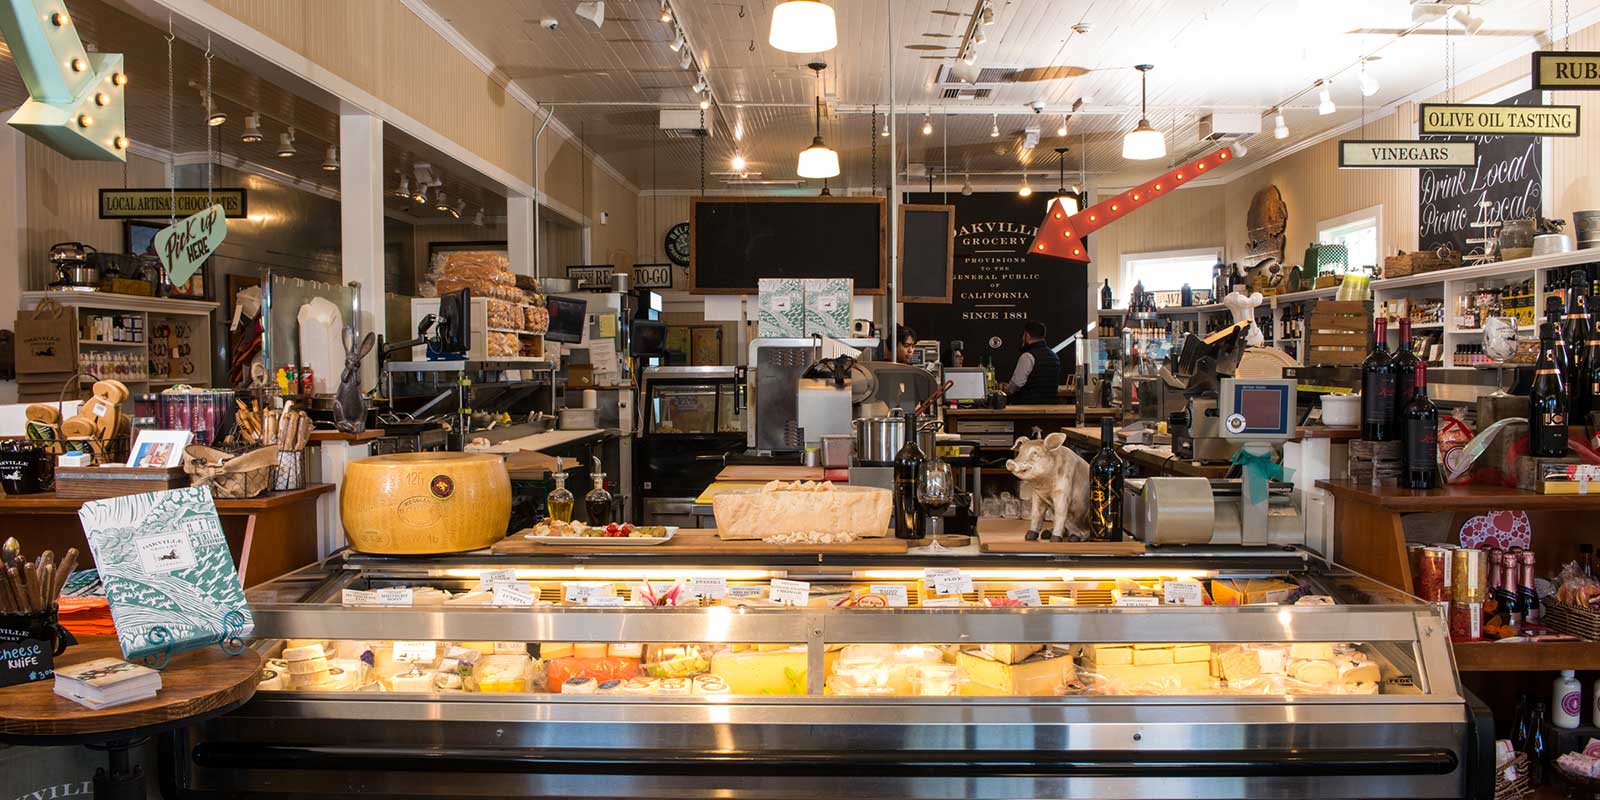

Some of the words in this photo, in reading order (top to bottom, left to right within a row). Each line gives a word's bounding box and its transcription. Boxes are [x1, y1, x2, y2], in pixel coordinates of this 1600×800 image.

[1429, 112, 1473, 127] OLIVE
[1478, 112, 1504, 127] OIL
[1508, 113, 1571, 128] TASTING
[1372, 148, 1449, 160] VINEGARS
[1420, 167, 1468, 205] Drink
[1470, 143, 1534, 192] Local
[106, 197, 135, 210] LOCAL
[179, 196, 238, 211] CHOCOTES
[1421, 203, 1467, 237] Picnic
[1474, 179, 1534, 224] Local
[962, 237, 1027, 246] GROCERY
[186, 236, 210, 263] HERE
[962, 312, 999, 320] SINCE
[1003, 312, 1028, 320] 1881
